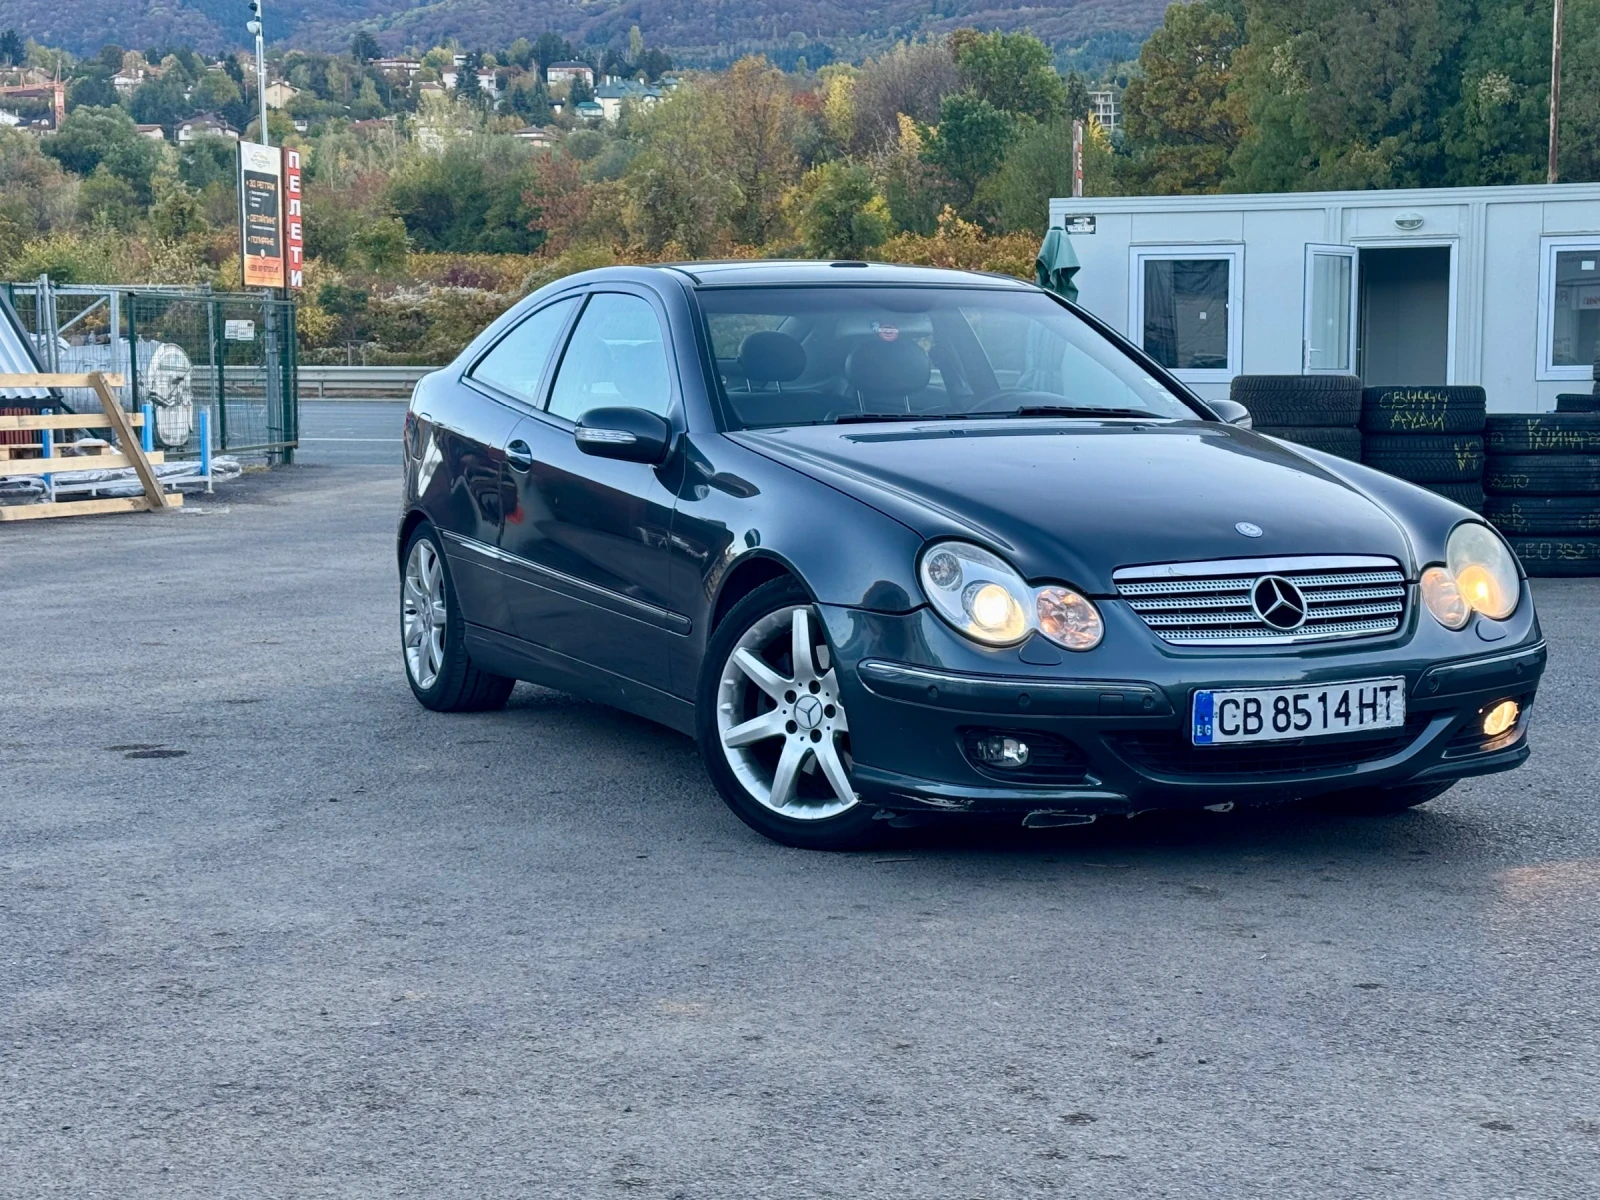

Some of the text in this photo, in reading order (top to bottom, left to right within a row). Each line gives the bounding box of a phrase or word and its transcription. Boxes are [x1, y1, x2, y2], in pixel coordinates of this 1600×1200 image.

[288, 150, 302, 287] ПЕЛЕТИ
[1196, 724, 1212, 737] BG
[1218, 697, 1263, 736] CB
[1272, 689, 1351, 732] 8514
